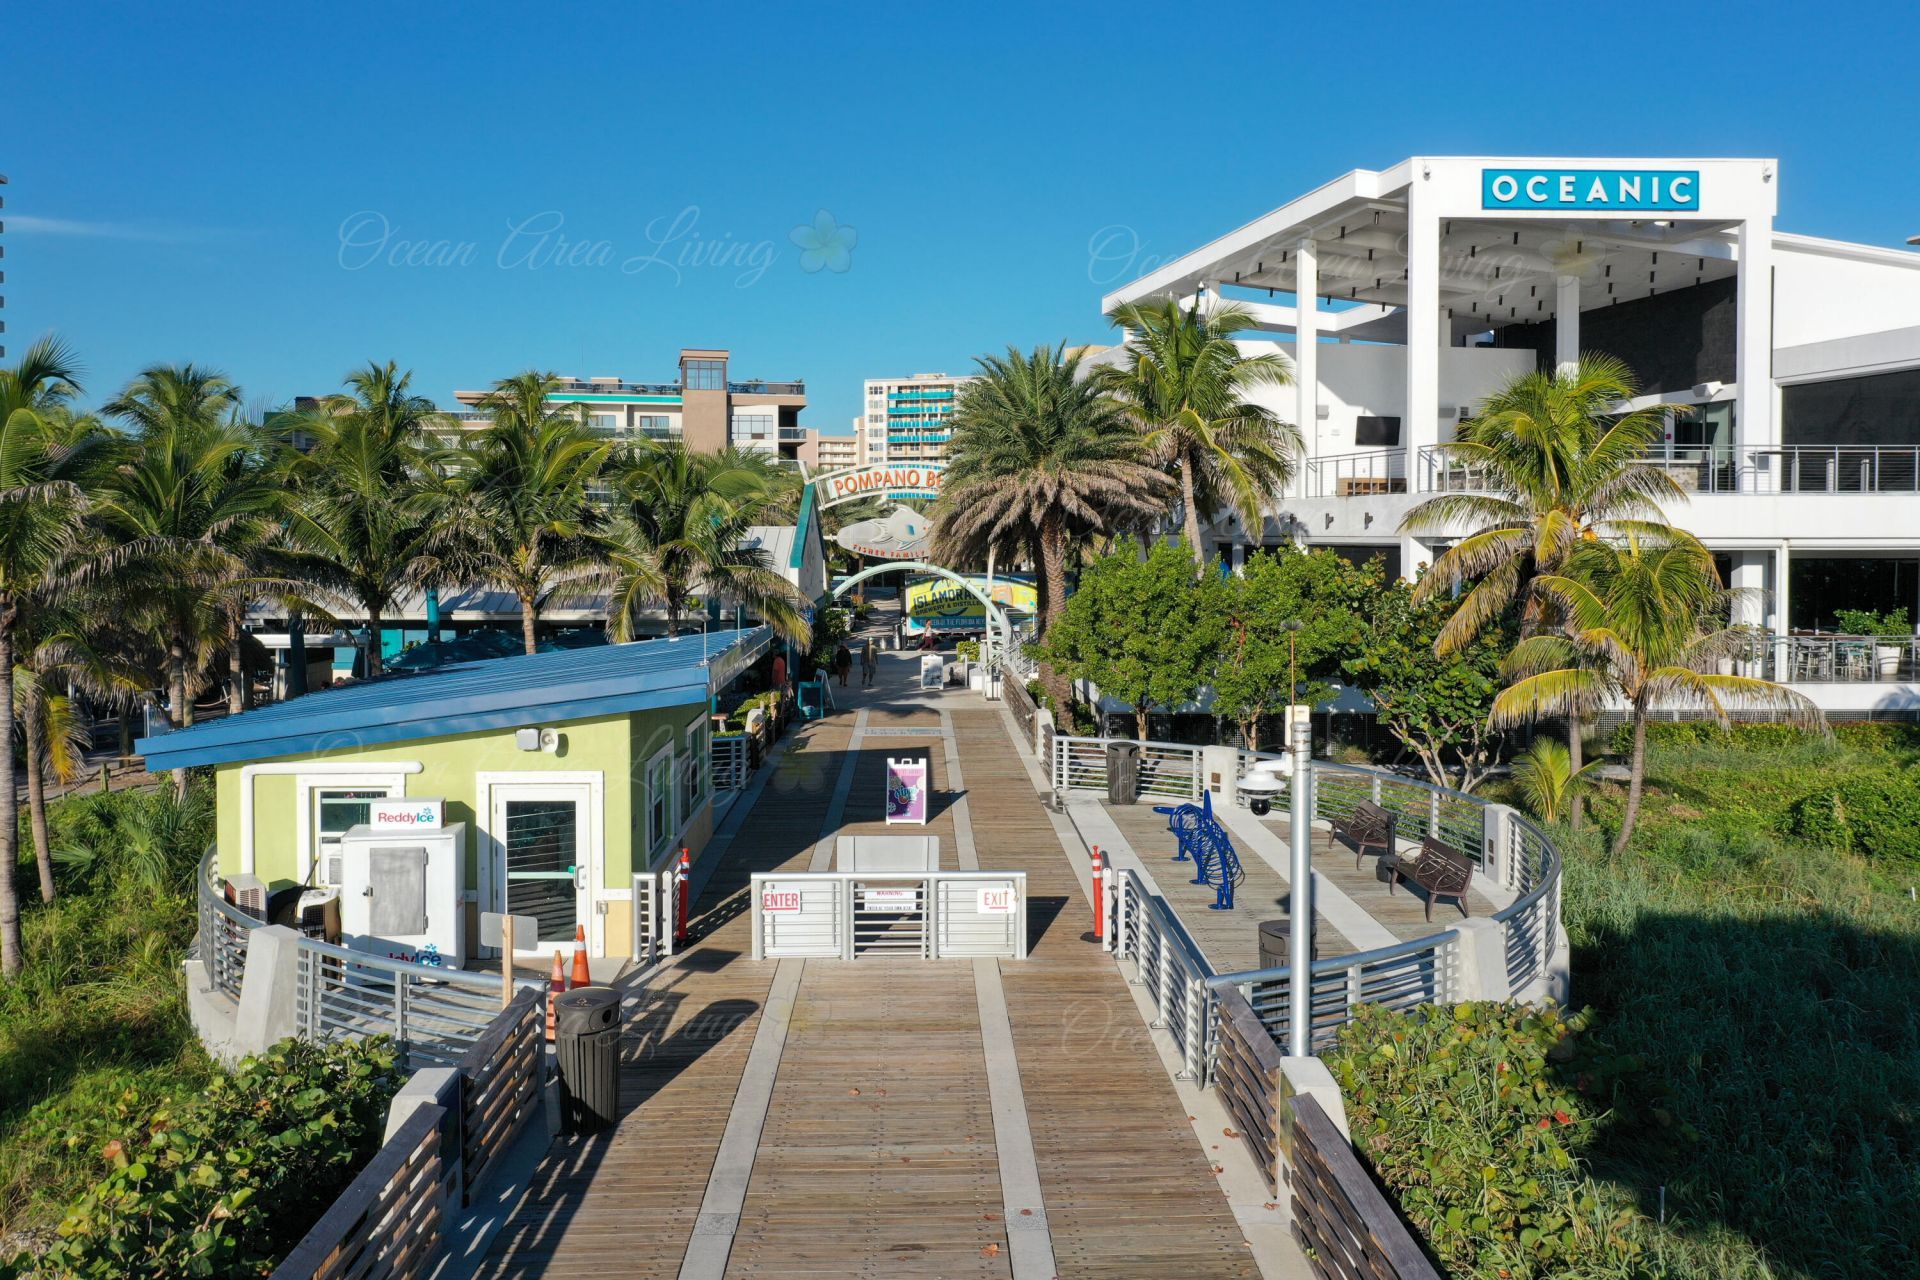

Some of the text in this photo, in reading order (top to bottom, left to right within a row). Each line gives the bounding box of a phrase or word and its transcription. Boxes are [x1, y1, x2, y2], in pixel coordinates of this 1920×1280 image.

[1492, 175, 1692, 203] OCEANIC
[833, 469, 920, 497] POMPANO
[764, 893, 799, 907] ENTER
[984, 891, 1008, 906] EXIT
